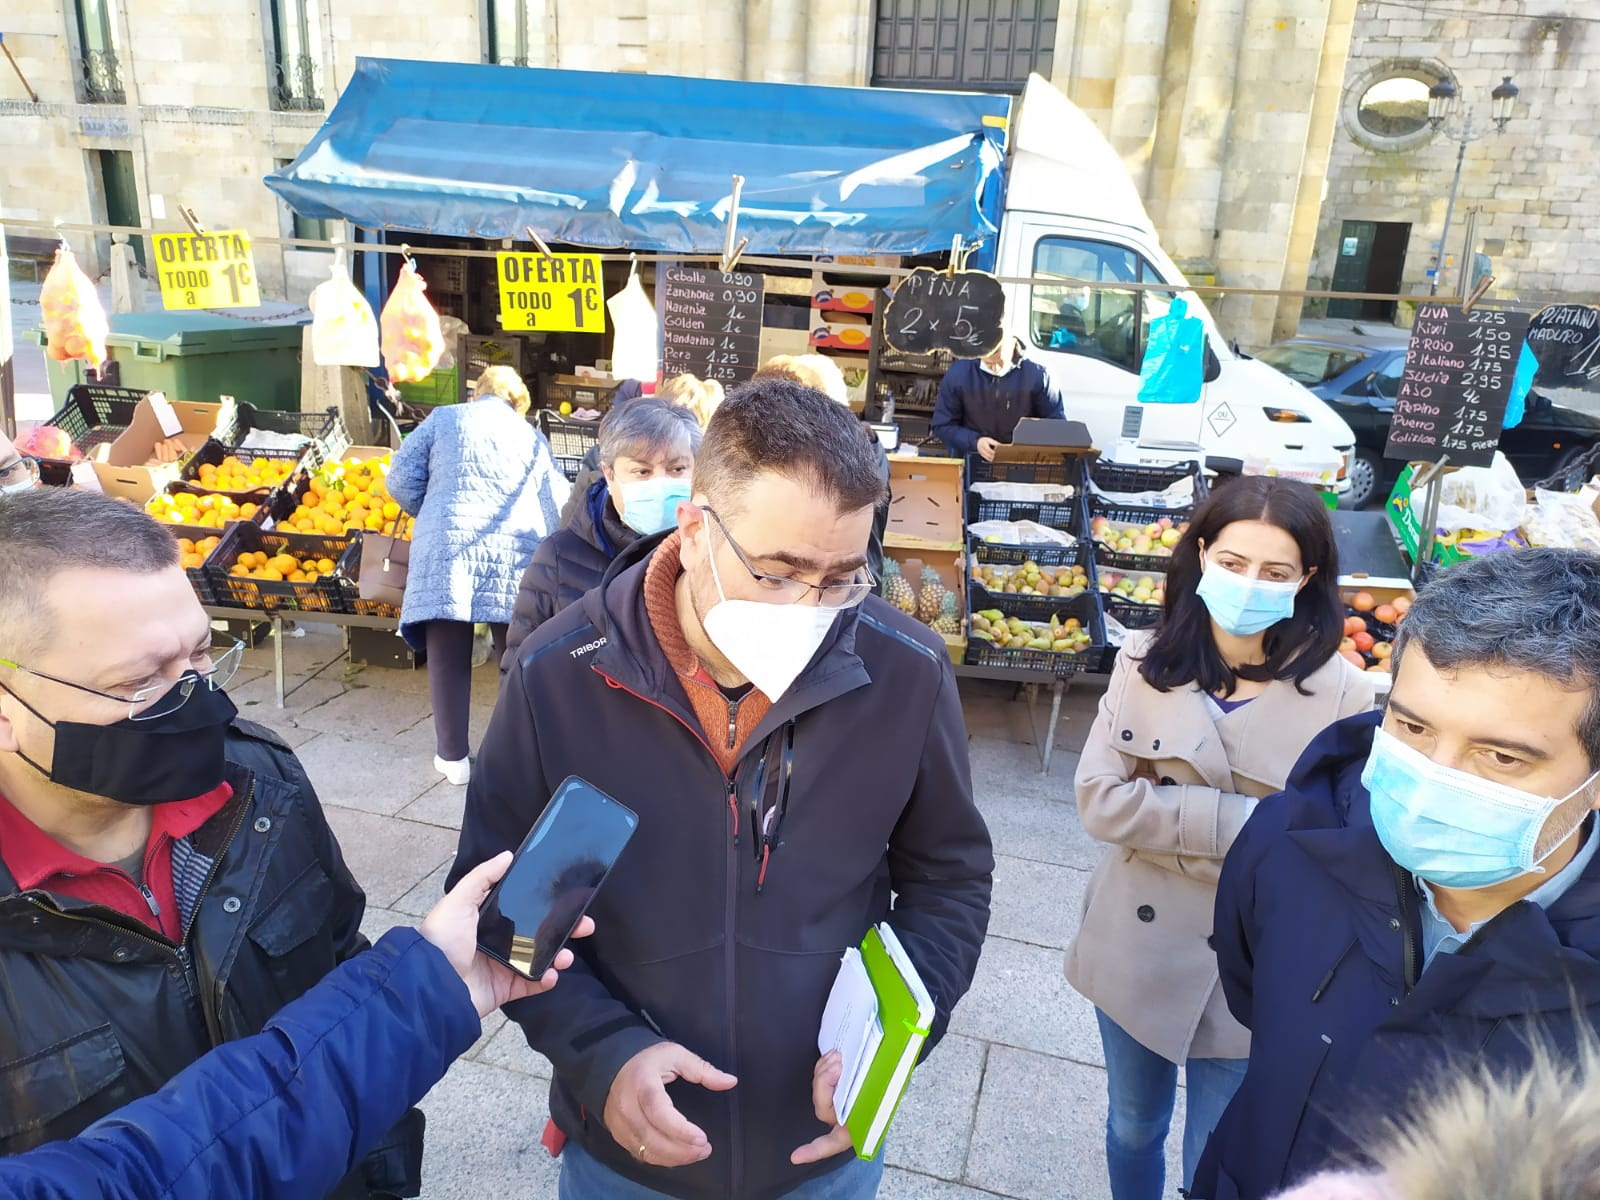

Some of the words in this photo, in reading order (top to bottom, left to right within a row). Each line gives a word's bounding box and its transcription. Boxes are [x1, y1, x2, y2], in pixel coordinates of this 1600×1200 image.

[159, 234, 247, 263] OFERTA
[504, 256, 596, 284] OFERTA
[666, 268, 706, 284] Cebolla
[165, 270, 210, 289] TODO
[186, 290, 196, 305] a
[506, 291, 552, 310] TODO
[526, 312, 536, 327] a
[900, 307, 923, 334] 2
[1419, 305, 1449, 319] UVA
[1527, 327, 1584, 345] MADURO
